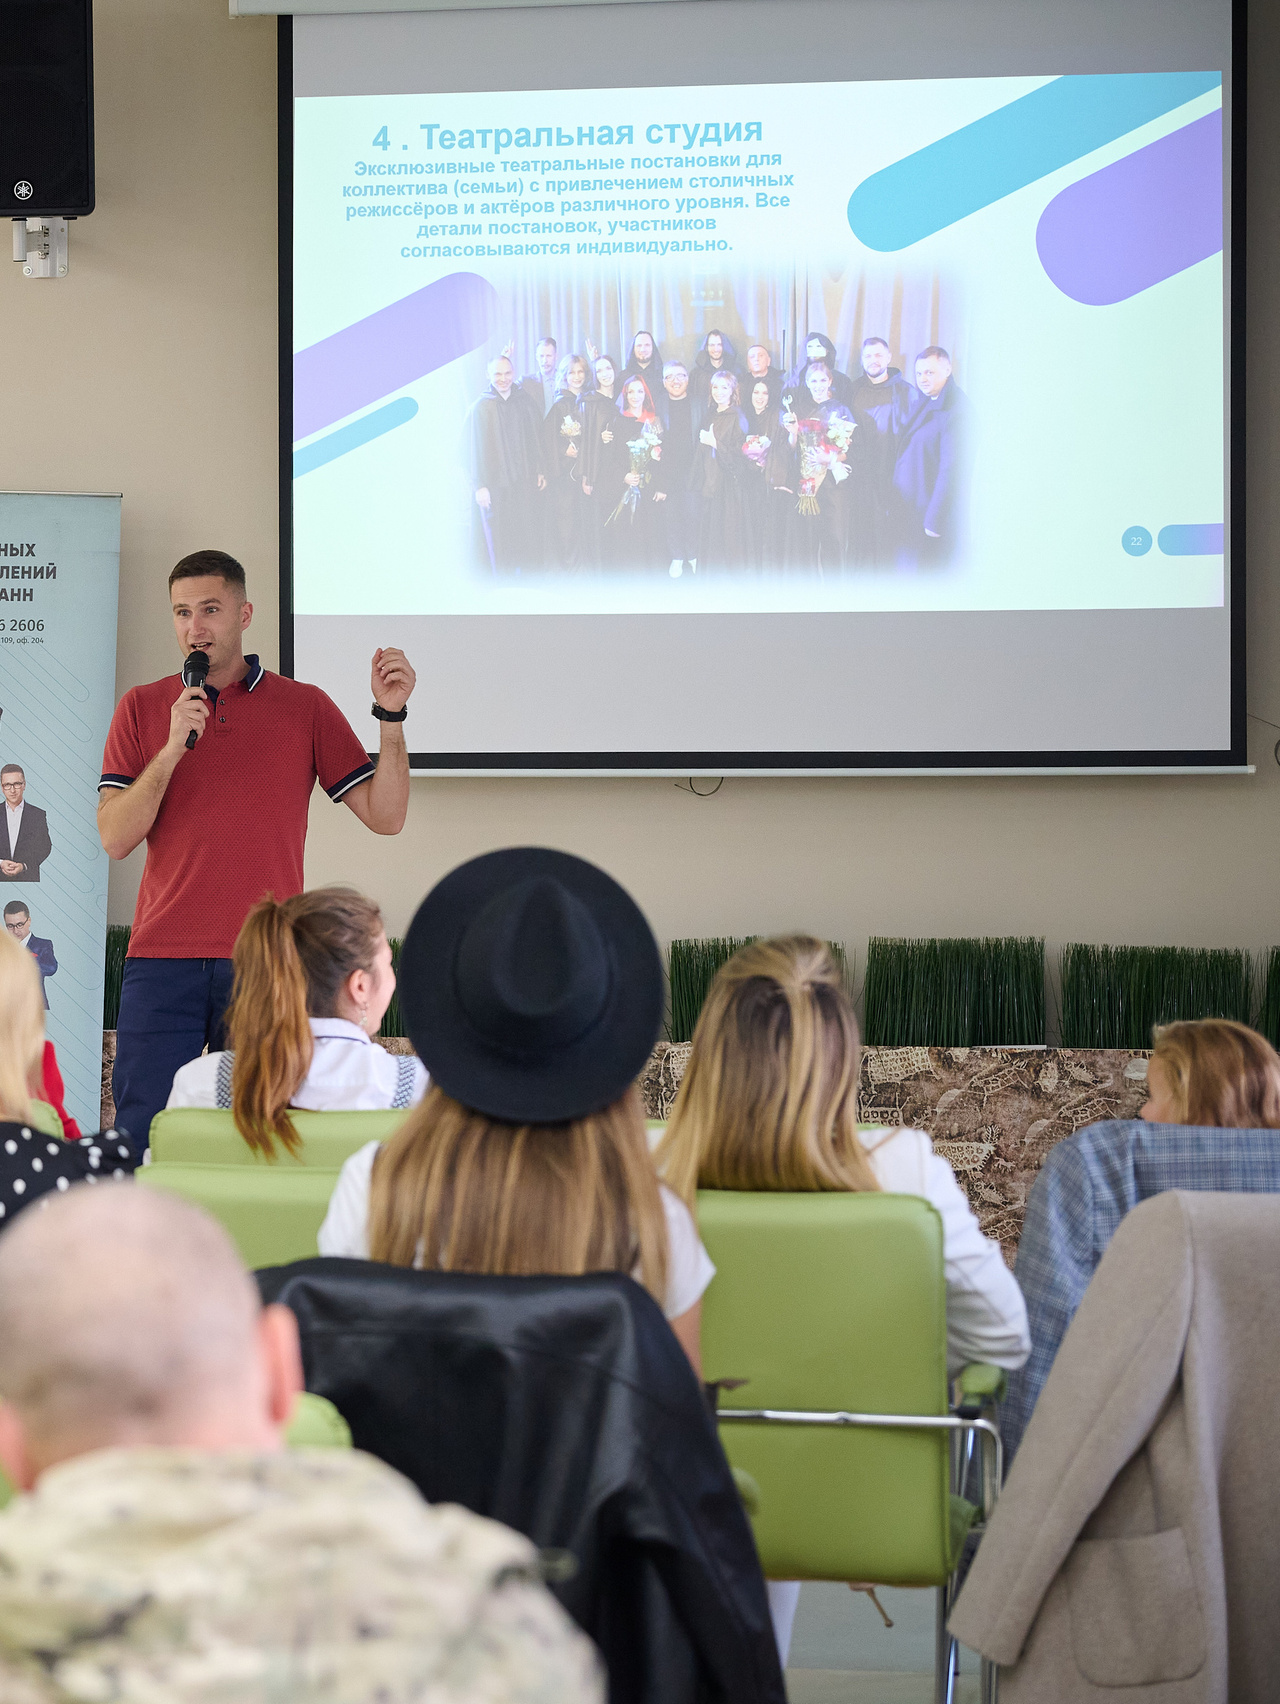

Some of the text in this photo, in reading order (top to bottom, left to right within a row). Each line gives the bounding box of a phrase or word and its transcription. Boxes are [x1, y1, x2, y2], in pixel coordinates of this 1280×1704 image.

[372, 125, 390, 151] 4
[420, 123, 633, 154] Театральная
[646, 121, 762, 150] студия
[354, 154, 782, 176] Эксклюзивные театральные постановки для
[342, 174, 795, 198] коллектива (семьи) с привлечением столичных
[346, 192, 791, 221] режиссёров и актёров различного уровня. Все
[416, 217, 717, 239] детали постановок, участников
[400, 239, 733, 258] согласовываются индивидуально.
[1130, 536, 1143, 546] 22
[9, 619, 45, 631] 2606
[17, 637, 29, 645] оф.
